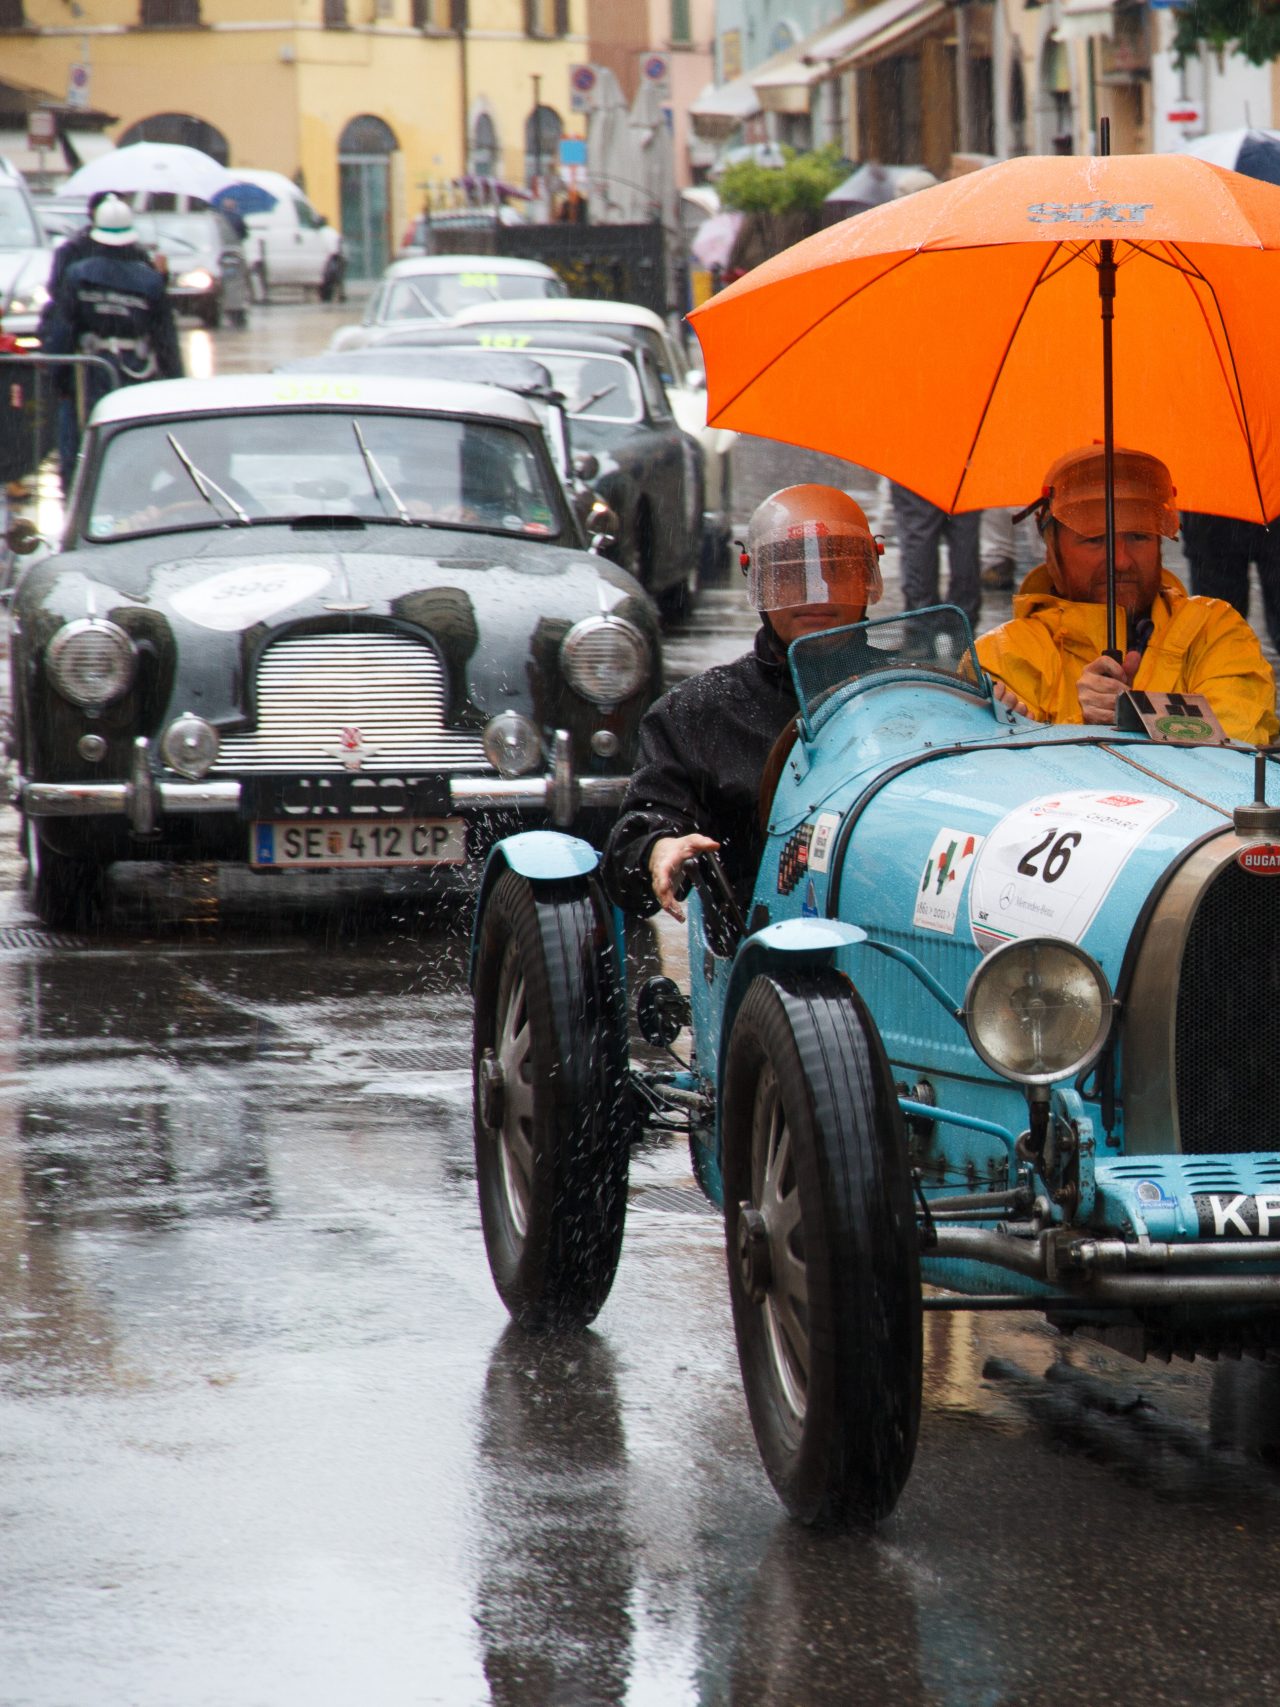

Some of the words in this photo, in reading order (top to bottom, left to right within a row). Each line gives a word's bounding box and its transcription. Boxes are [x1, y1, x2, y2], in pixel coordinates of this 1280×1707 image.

[284, 827, 323, 858] SE
[349, 827, 403, 857] 412
[411, 826, 449, 857] CP
[1017, 827, 1082, 884] 26
